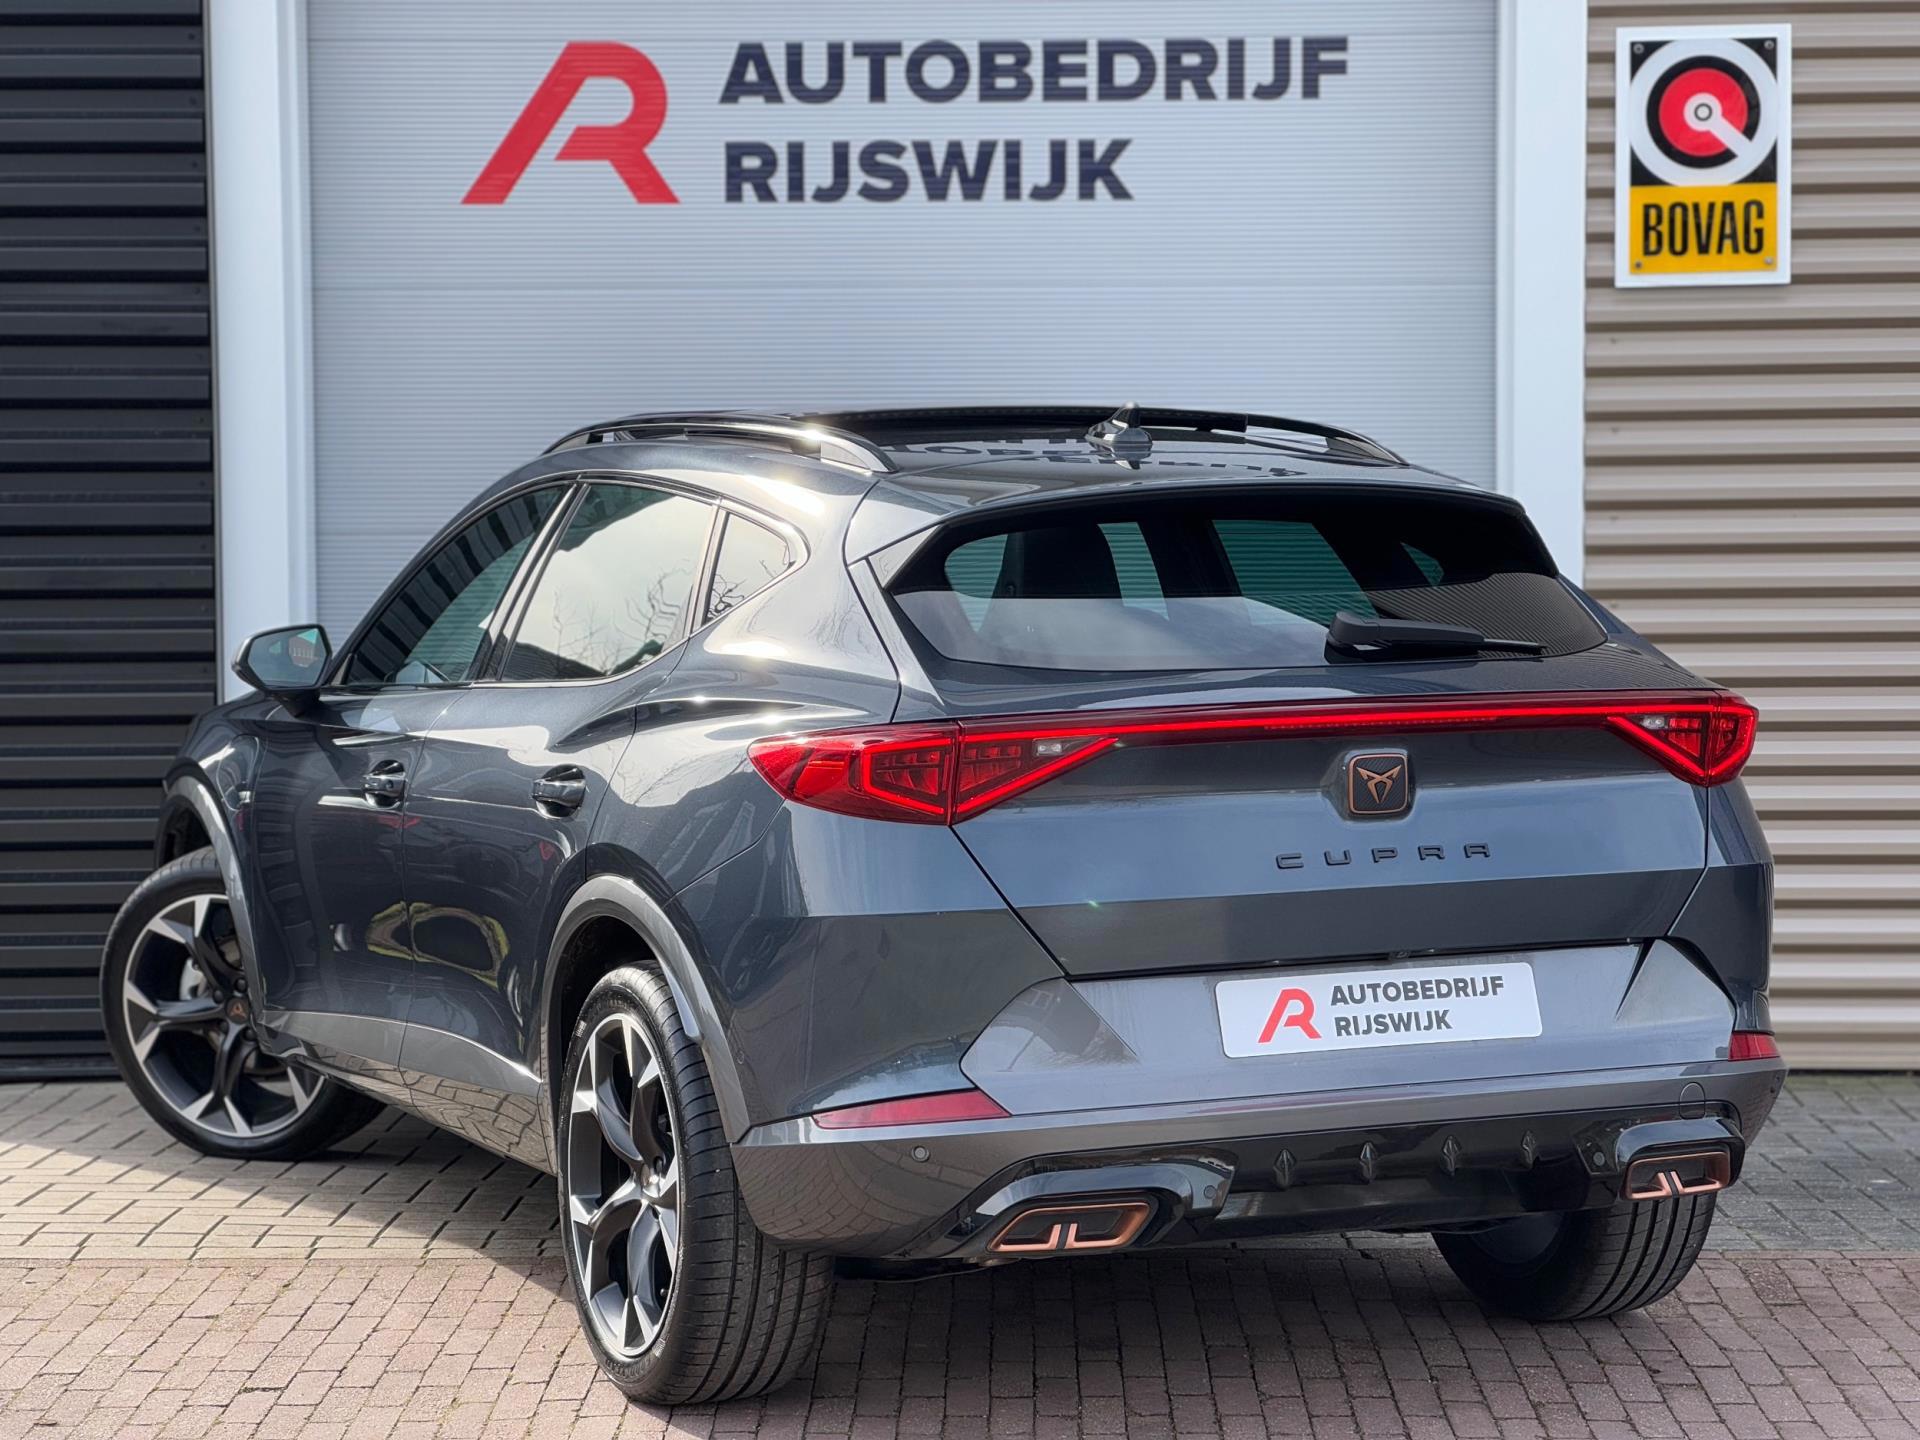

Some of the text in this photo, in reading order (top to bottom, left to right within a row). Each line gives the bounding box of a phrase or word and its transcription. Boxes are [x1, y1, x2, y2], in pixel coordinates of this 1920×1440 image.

[719, 36, 1349, 104] AUTOBEDRIJF
[724, 139, 1134, 203] RIJSWIJK
[1643, 199, 1765, 256] BOVAG
[1275, 842, 1492, 870] CUPRA
[1330, 975, 1504, 1006] AUTOBEDRIJF
[1334, 1009, 1453, 1037] RIJSWIJK
